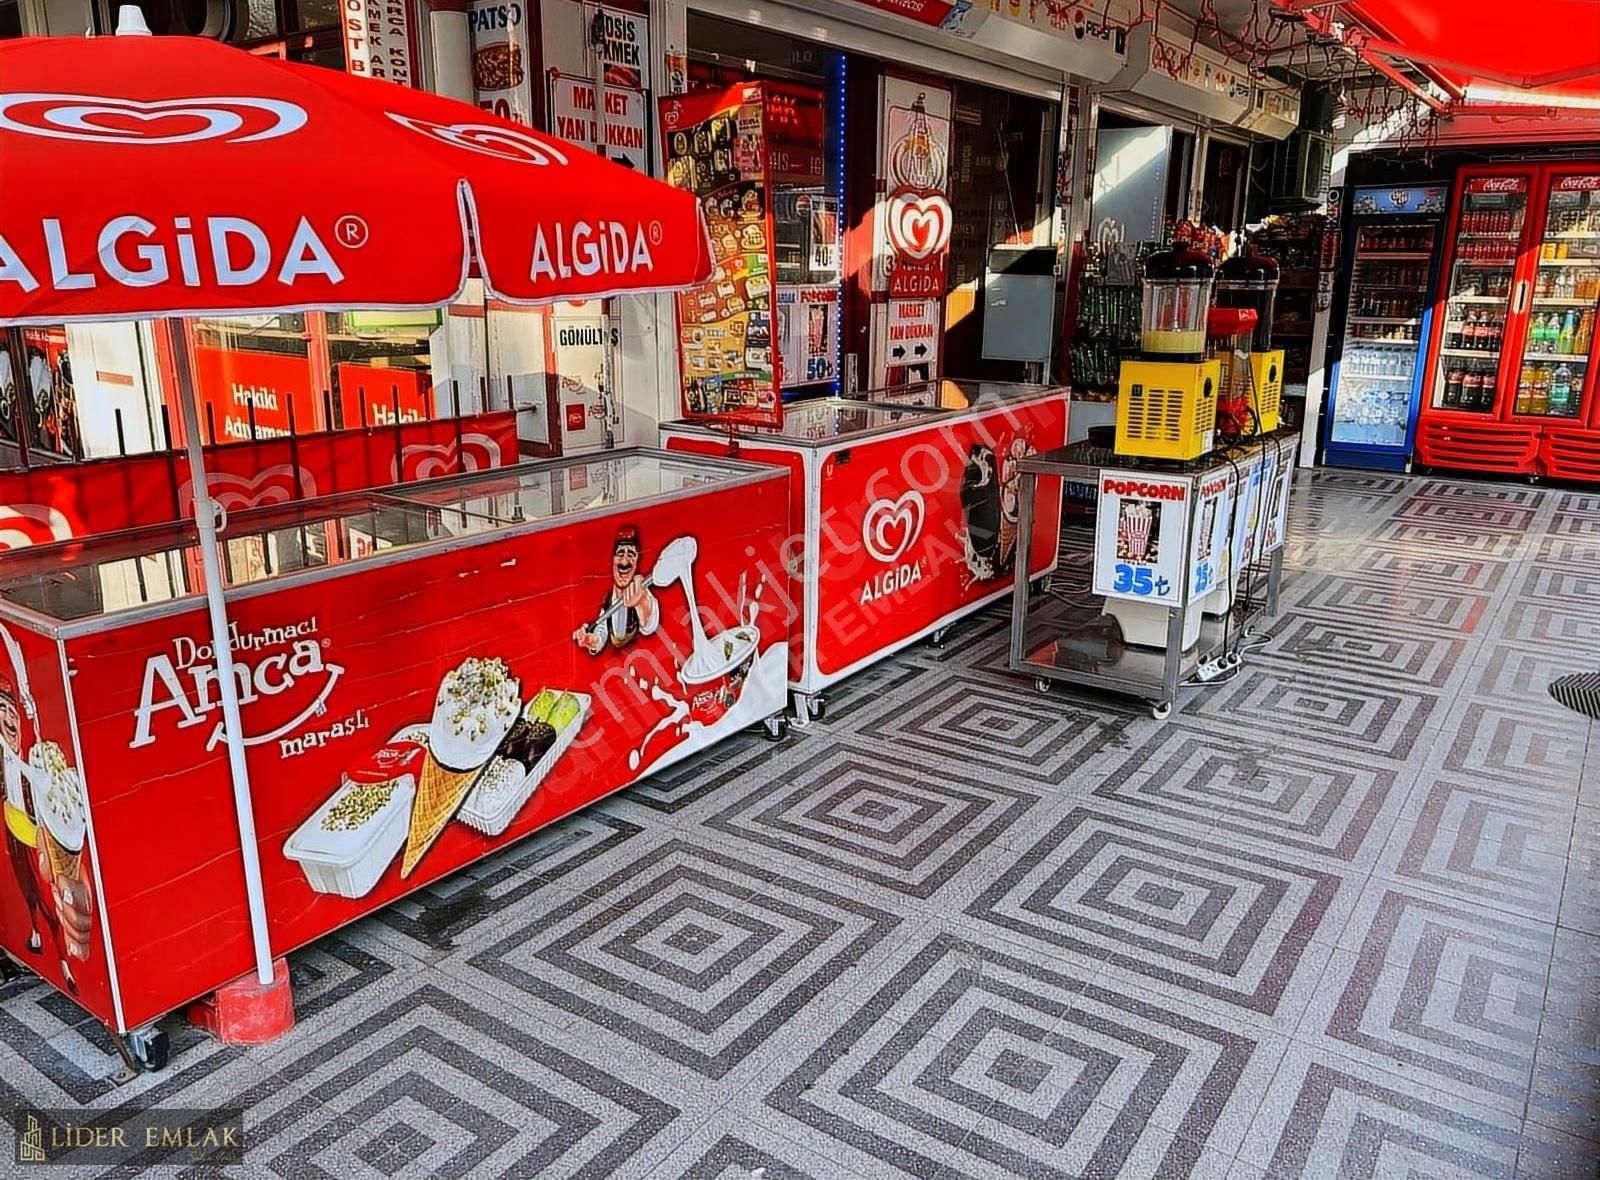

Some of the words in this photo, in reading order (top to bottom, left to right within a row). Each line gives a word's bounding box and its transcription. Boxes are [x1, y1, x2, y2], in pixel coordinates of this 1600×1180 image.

[602, 39, 640, 66] KMEK
[572, 86, 629, 116] MAKET
[556, 116, 586, 142] YAN
[1102, 478, 1187, 501] POPCORN
